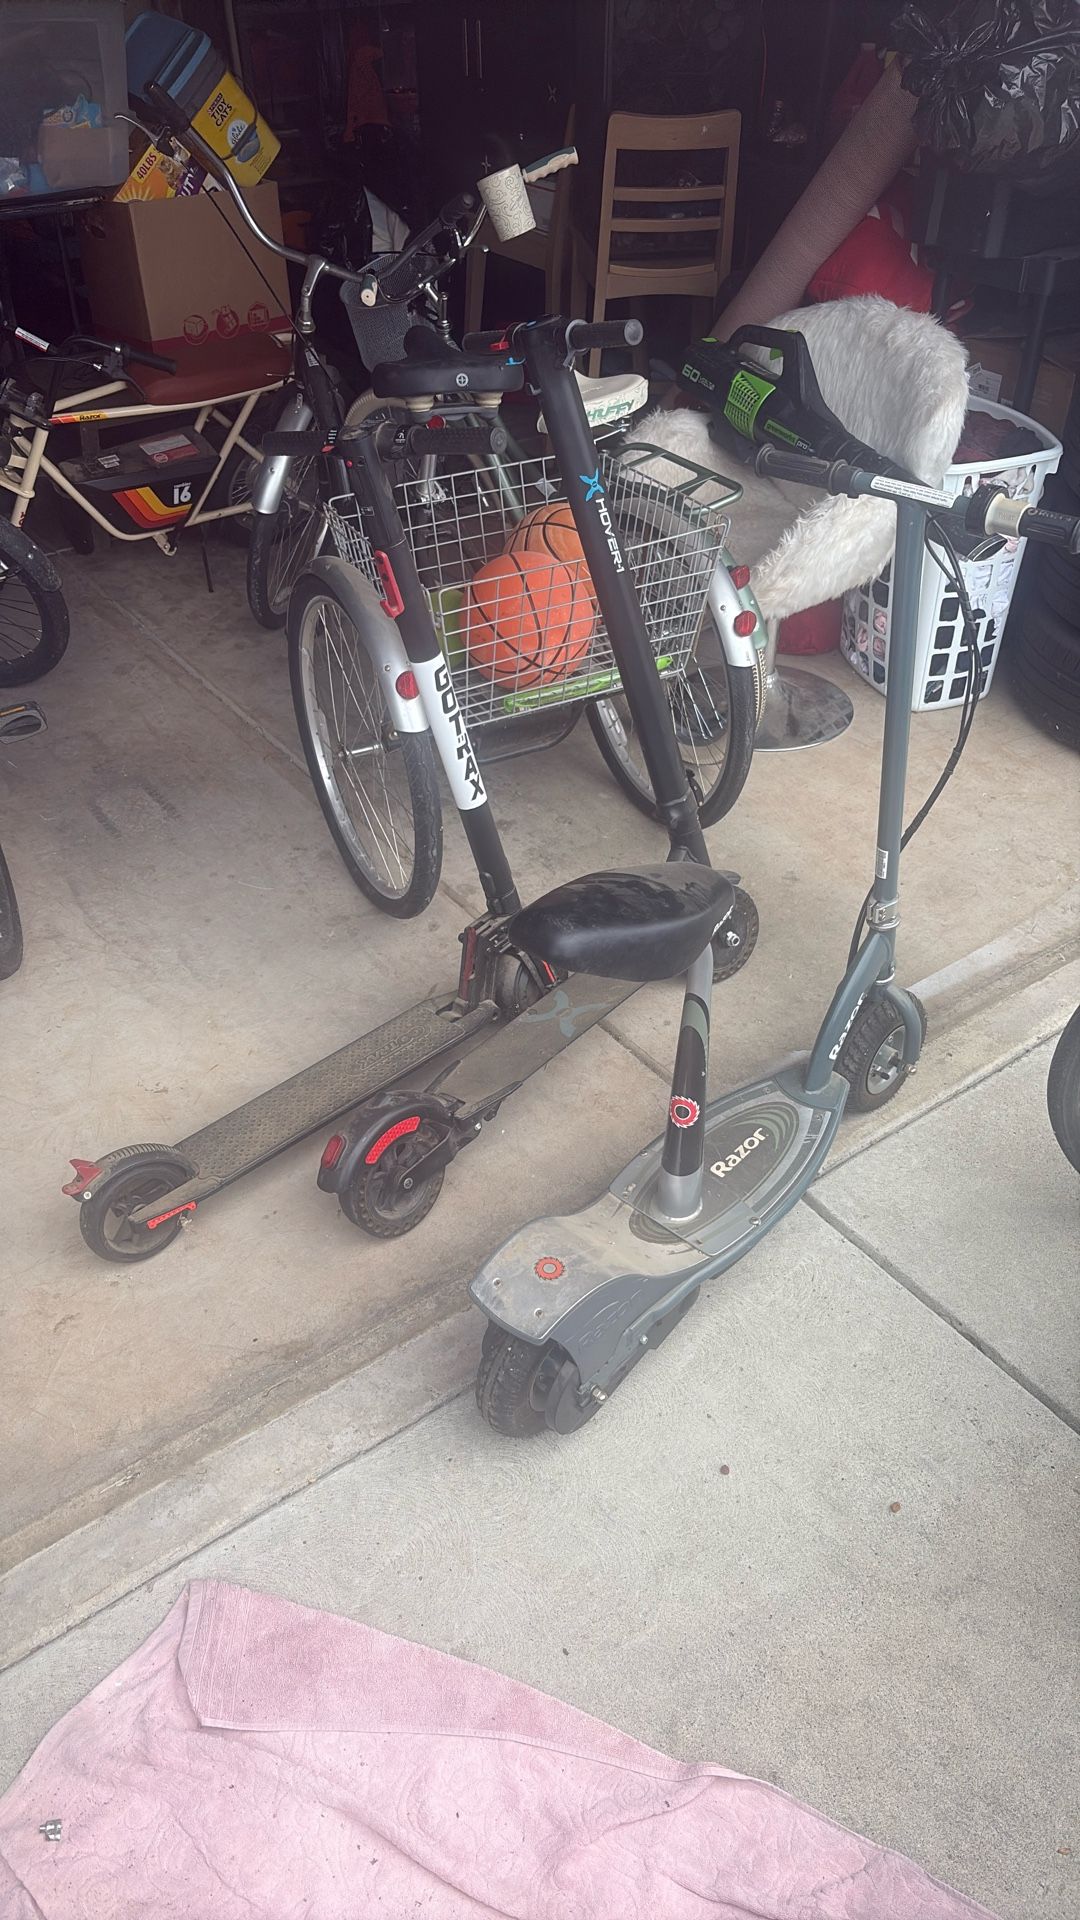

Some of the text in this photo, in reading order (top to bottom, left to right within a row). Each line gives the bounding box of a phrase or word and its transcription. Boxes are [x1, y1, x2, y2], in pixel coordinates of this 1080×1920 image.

[211, 98, 227, 120] TIDY
[215, 103, 233, 127] CATS
[136, 152, 157, 180] 40LBS
[682, 363, 701, 383] 60
[587, 399, 635, 419] HUFFY
[173, 486, 192, 505] 16
[595, 498, 625, 573] HOVER-1
[434, 664, 484, 801] GOTRAX
[829, 992, 866, 1061] Razor
[710, 1127, 767, 1178] Razor
